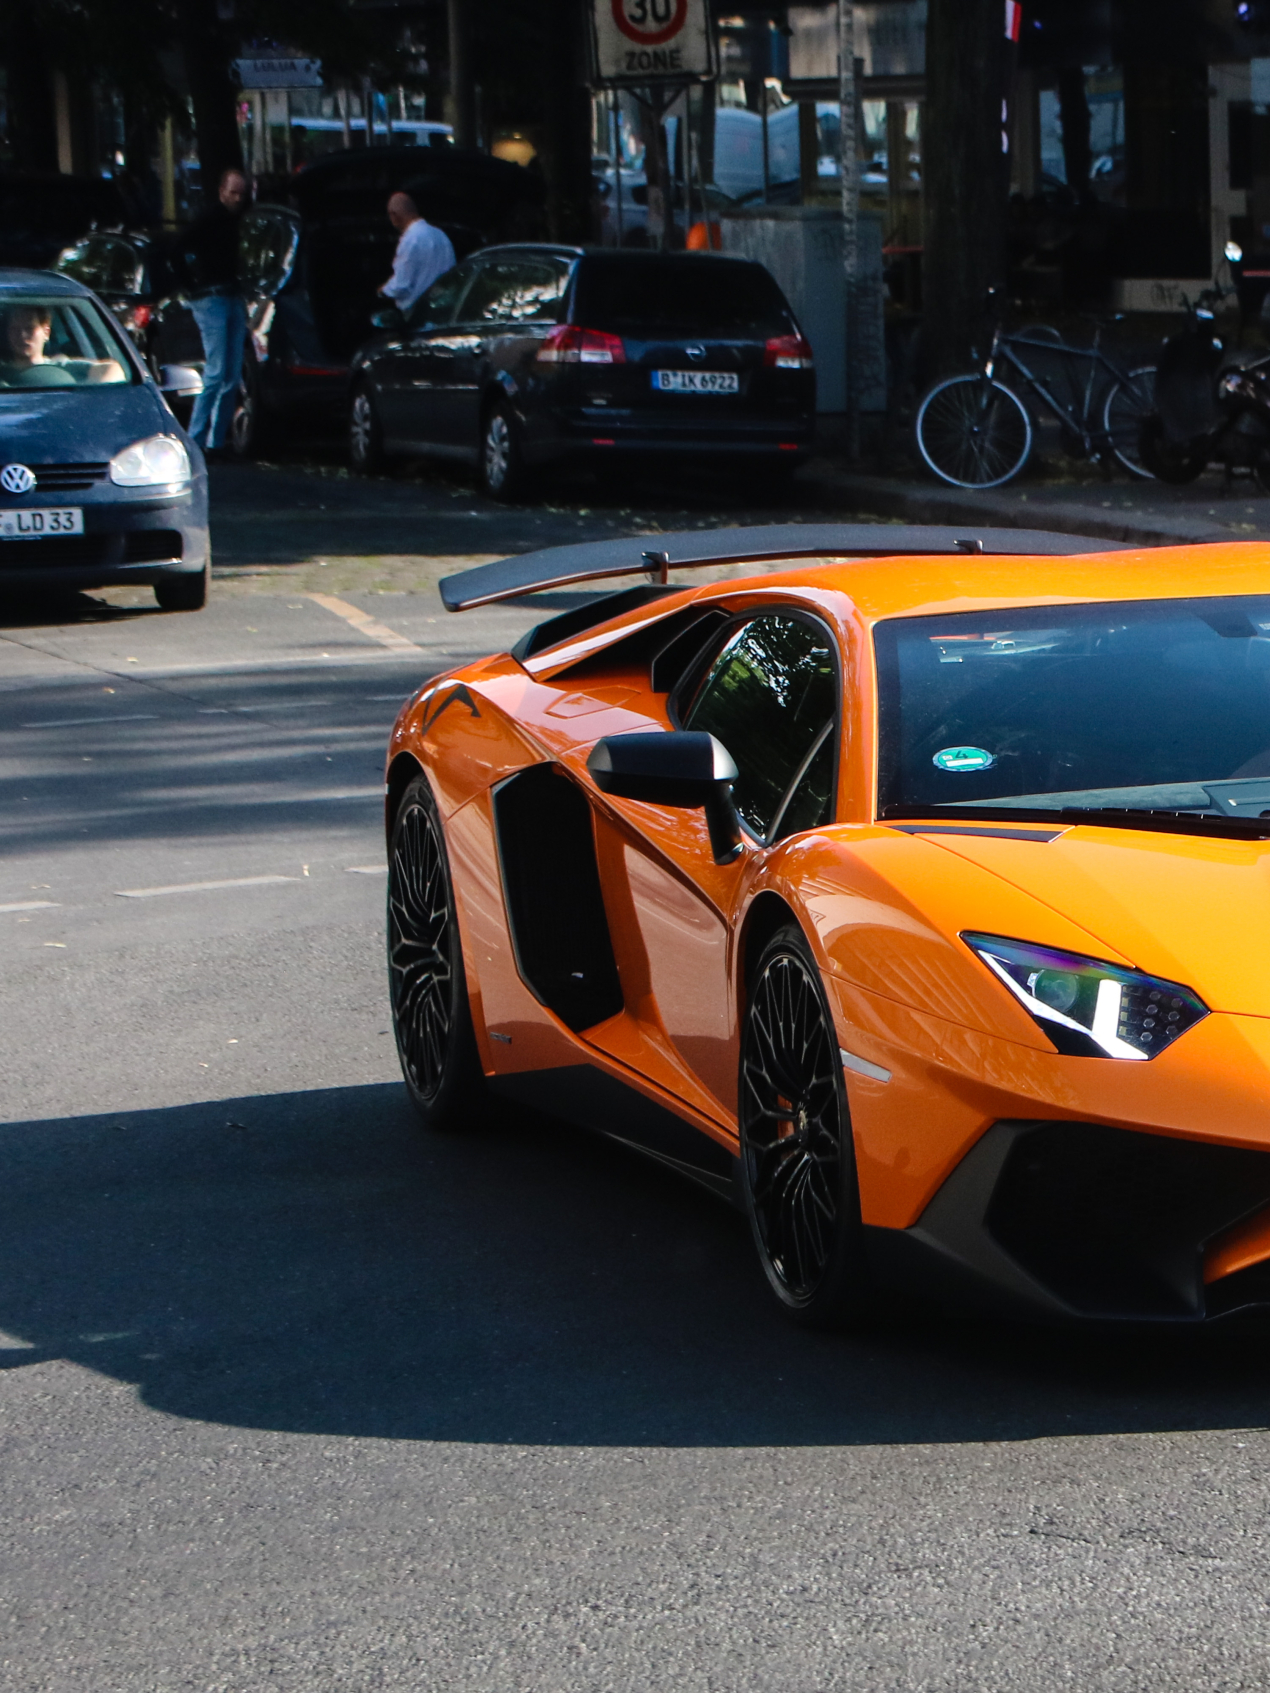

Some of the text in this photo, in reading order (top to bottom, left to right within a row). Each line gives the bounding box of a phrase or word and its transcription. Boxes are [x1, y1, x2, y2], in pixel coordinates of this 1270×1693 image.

[628, 0, 671, 24] 30
[625, 49, 682, 71] ZONE
[661, 373, 735, 390] B IK 6922
[17, 512, 44, 532] LD
[49, 511, 74, 531] 33
